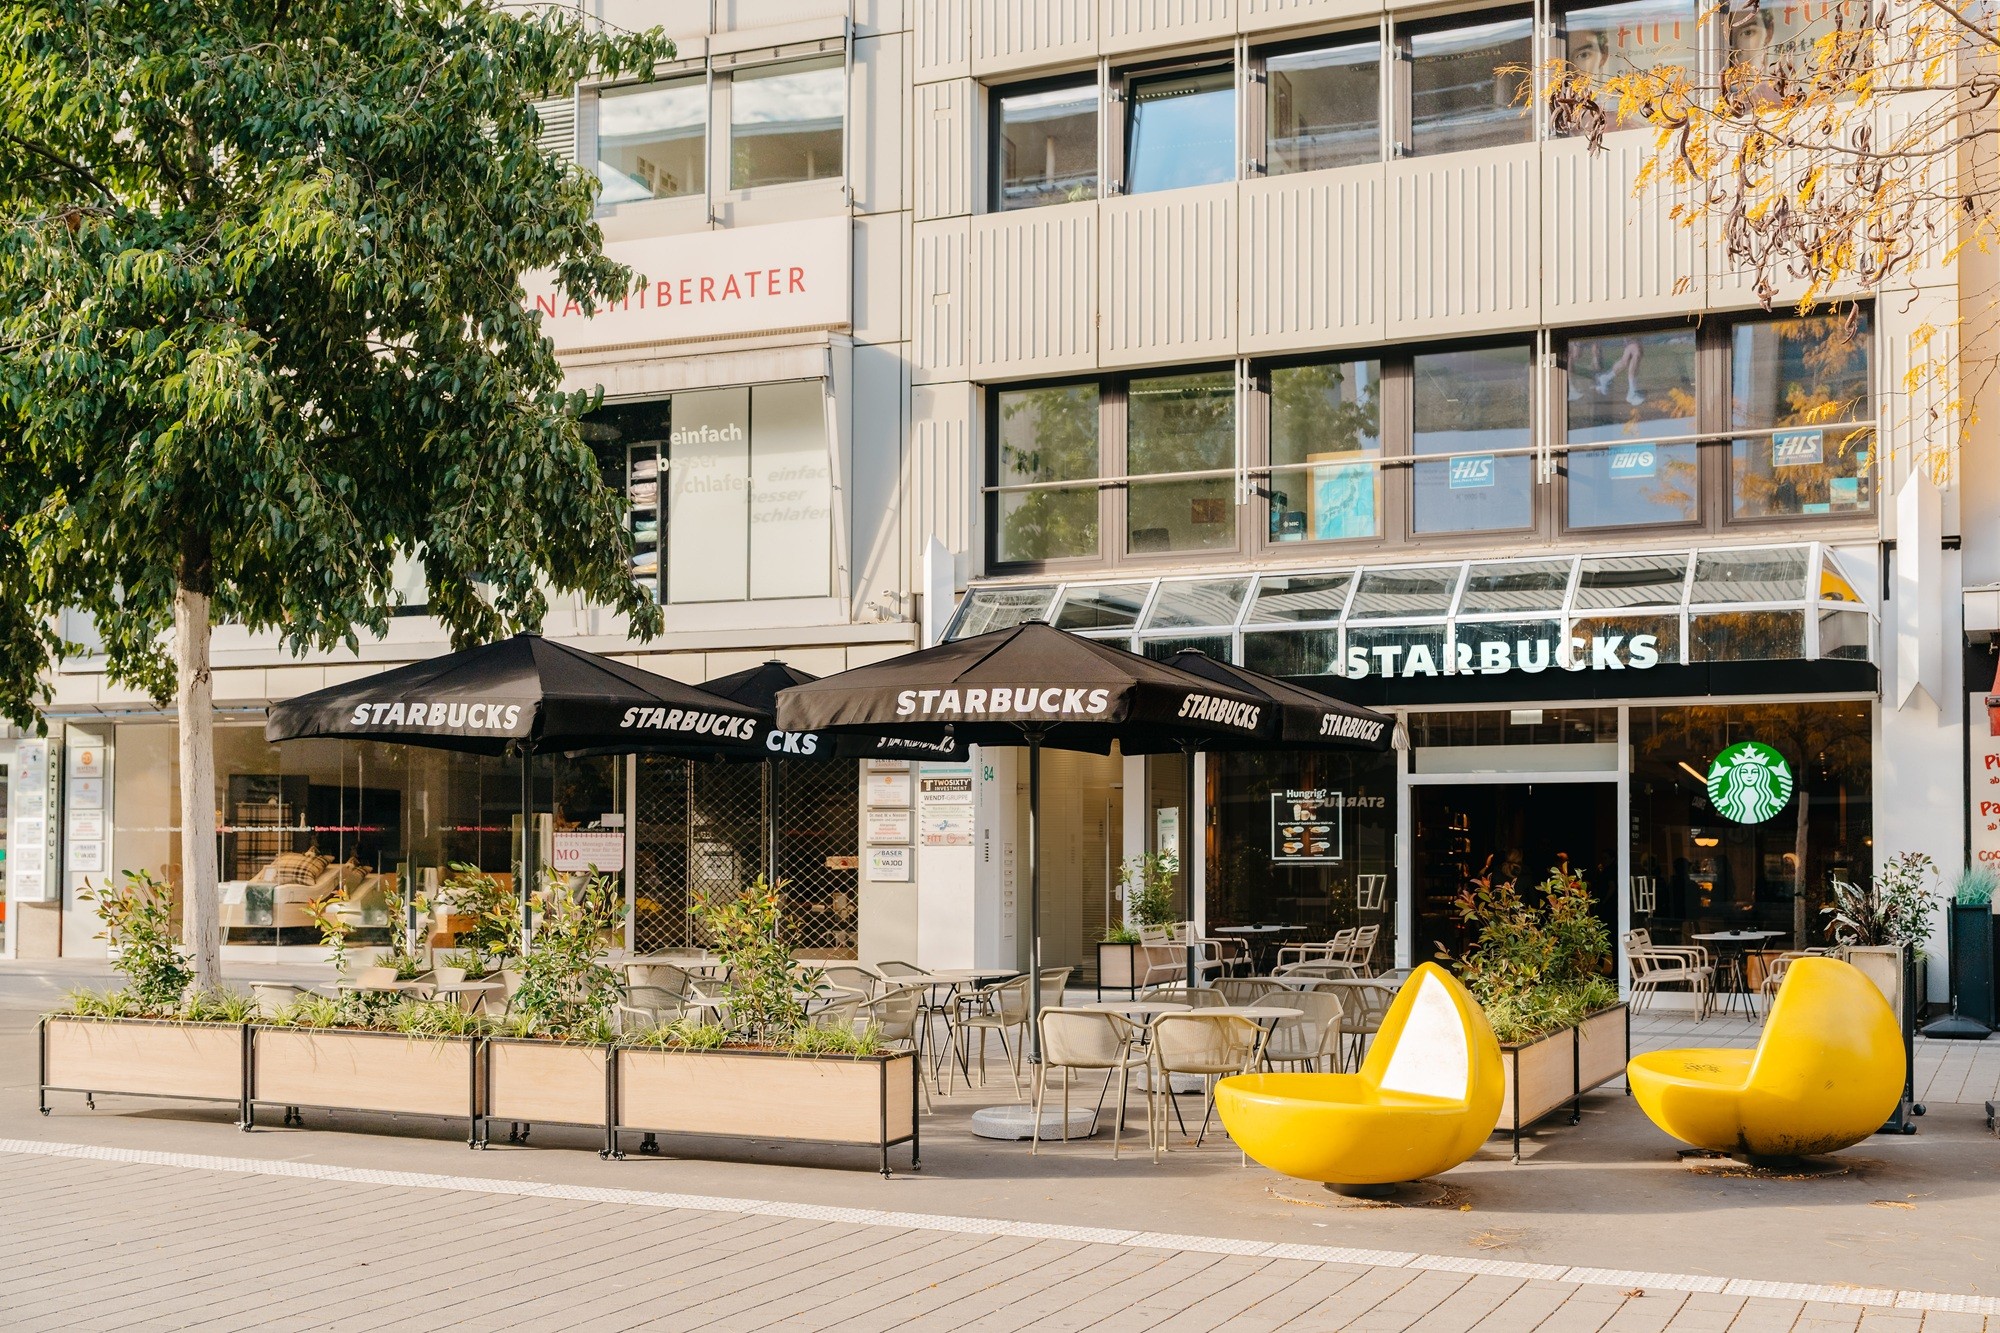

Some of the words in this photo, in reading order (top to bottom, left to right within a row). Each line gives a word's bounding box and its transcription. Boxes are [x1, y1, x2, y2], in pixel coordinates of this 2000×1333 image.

[1616, 11, 1687, 48] FITT
[670, 423, 742, 446] einfach
[1346, 633, 1659, 680] STARBUCKS
[350, 702, 522, 730] STARBUCKS
[896, 688, 1110, 716] STARBUCKS
[1178, 693, 1261, 730] STARBUCKS
[619, 706, 757, 740] STARBUCKS
[1319, 713, 1385, 742] STARBUCKS
[983, 765, 994, 782] 84
[1286, 788, 1327, 800] Hungrig?
[556, 848, 580, 861] MO
